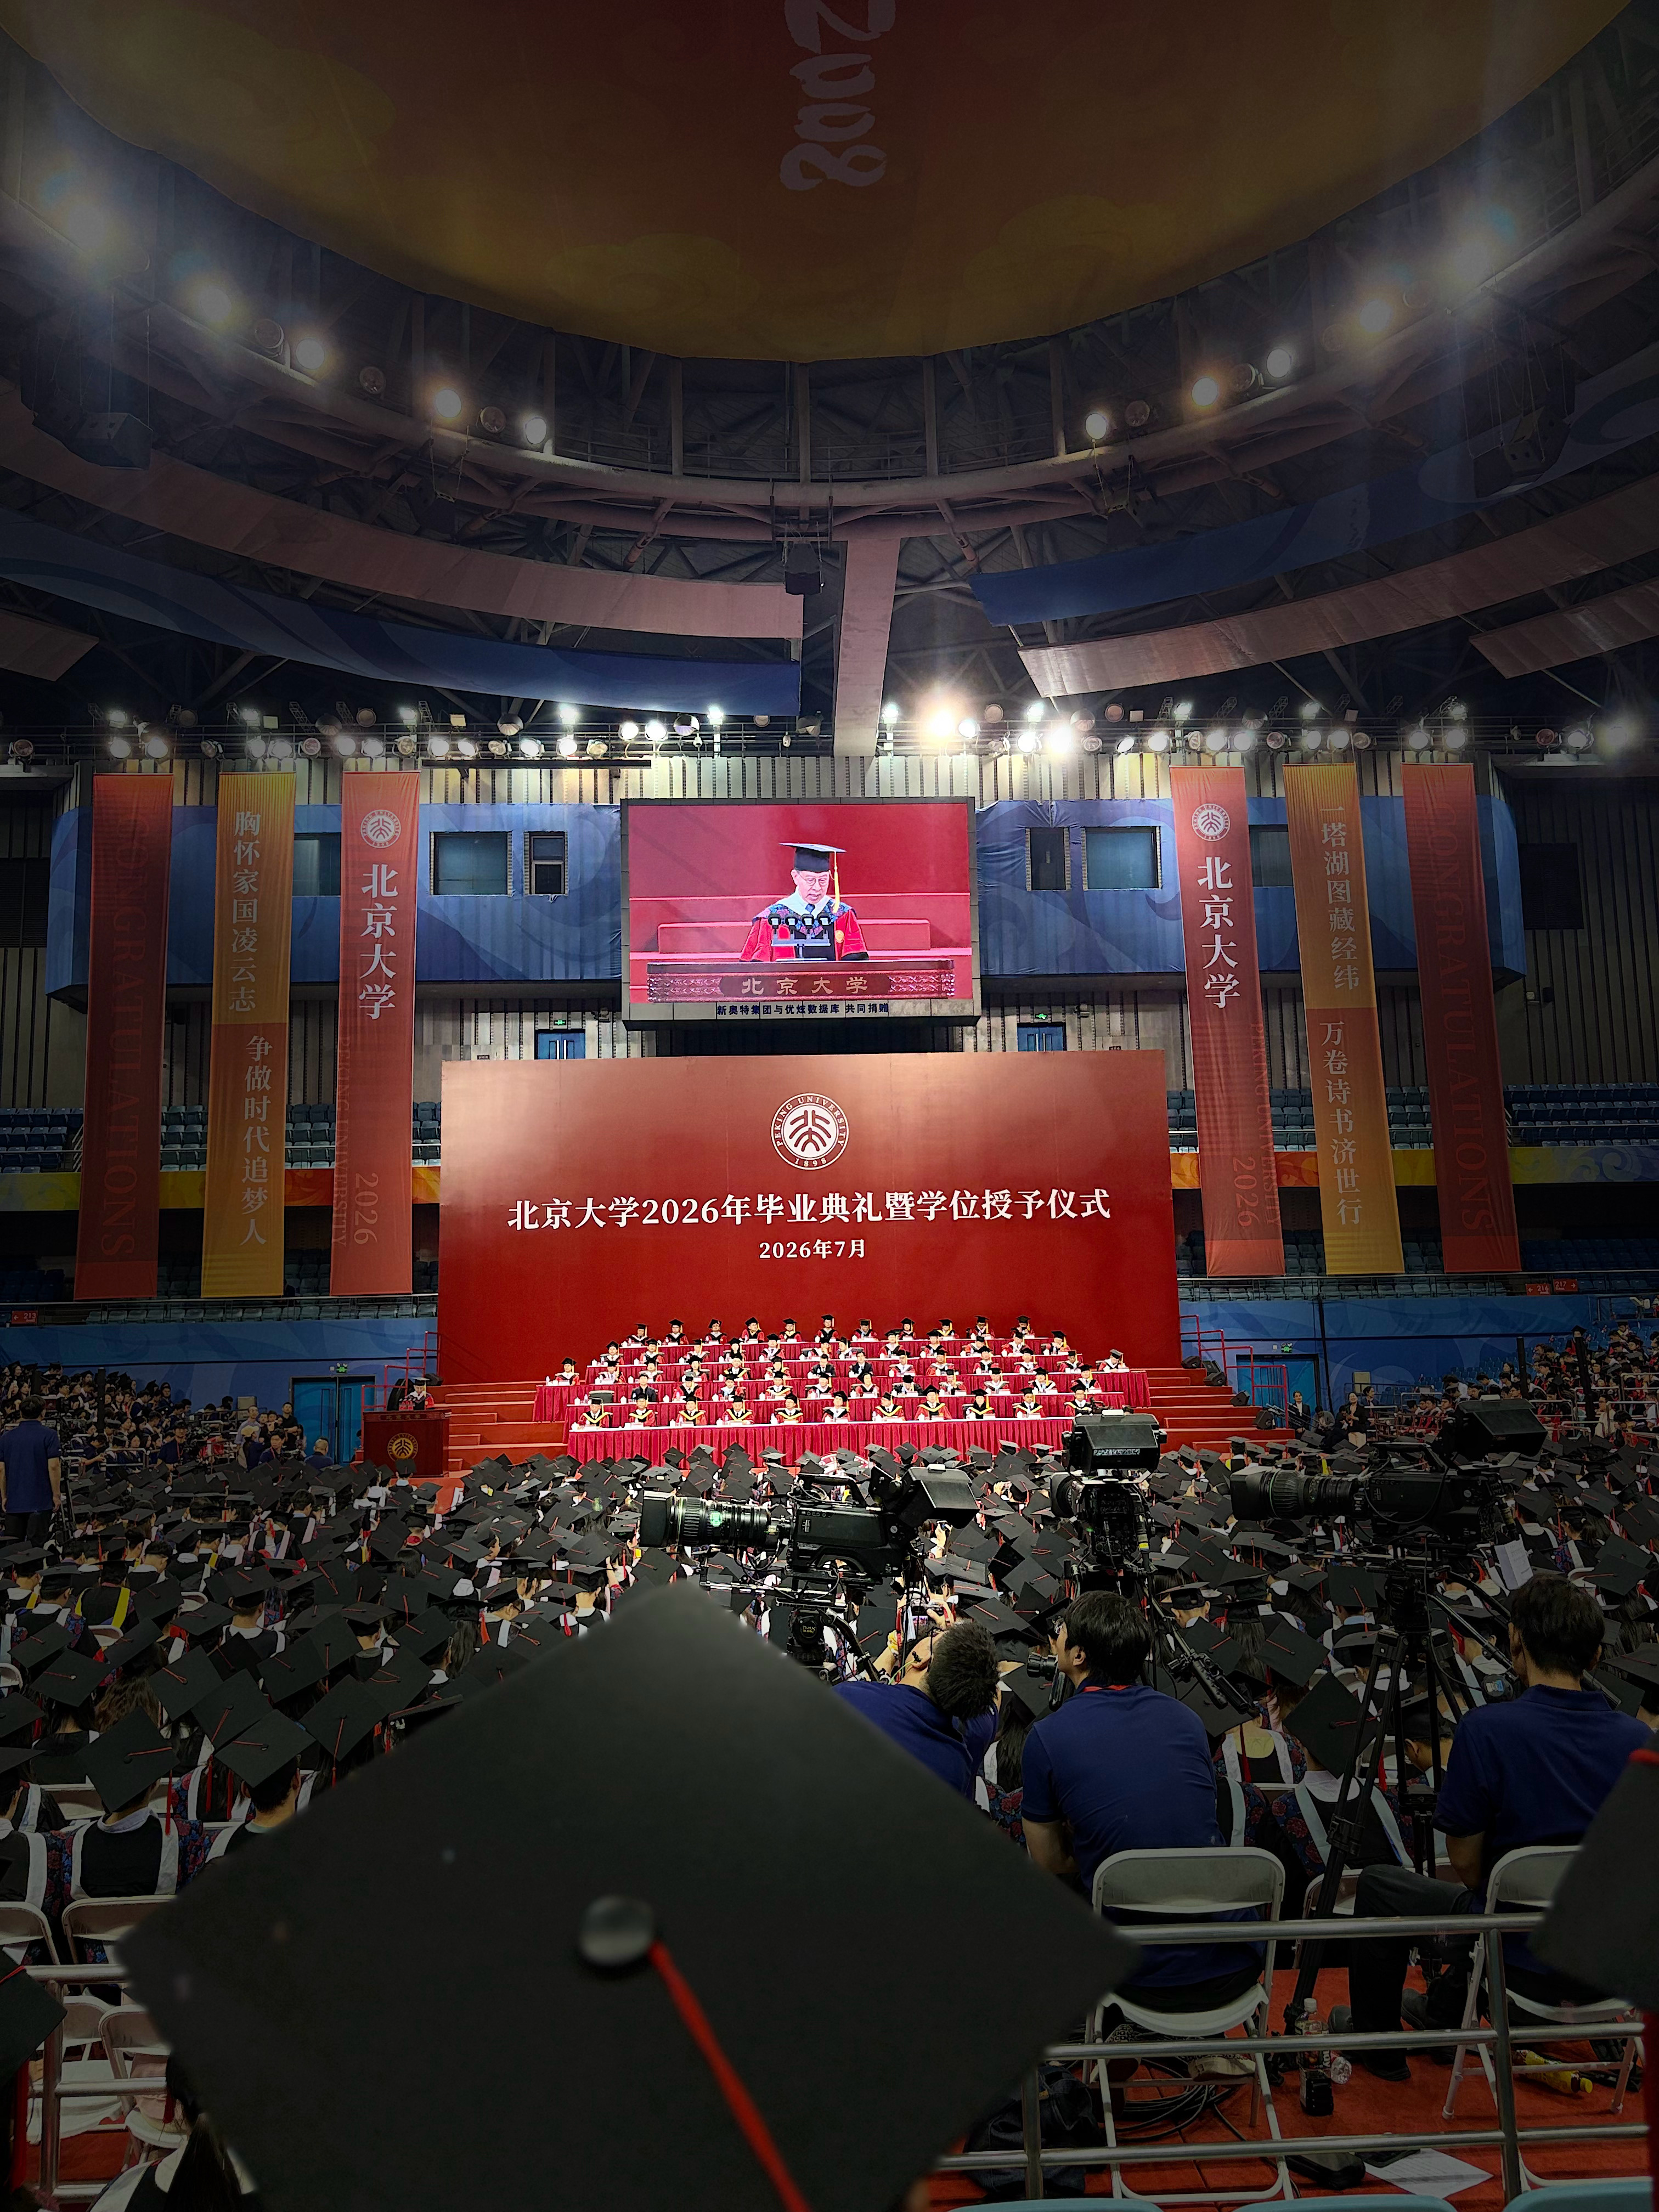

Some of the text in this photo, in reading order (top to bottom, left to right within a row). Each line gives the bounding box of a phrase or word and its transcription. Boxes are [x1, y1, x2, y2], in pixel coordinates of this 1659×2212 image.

[228, 810, 261, 1013] 胸怀家国凌云志
[358, 864, 398, 1020] 北京大学
[1197, 855, 1241, 1009] 北京大学
[1318, 806, 1359, 991] 一塔湖图藏经纬
[100, 816, 151, 1257] CONGRATULATIONS
[716, 1003, 889, 1015] 新奥特集团与优炫数据库 共同捐赠
[741, 977, 868, 995] 北京大学
[1429, 803, 1493, 1233] CONGRATULATIONS
[239, 1035, 273, 1246] 争做时代追梦人
[774, 1096, 847, 1147] PEKING UNIVERSITY
[794, 1157, 827, 1167] 1898
[1319, 1020, 1363, 1226] 万卷诗书济世行
[354, 1172, 379, 1245] 2026
[507, 1188, 1111, 1231] 北京大学2026年毕业典礼暨学位授予仪式
[759, 1238, 865, 1259] 2026年7月
[1233, 1157, 1259, 1227] 2026
